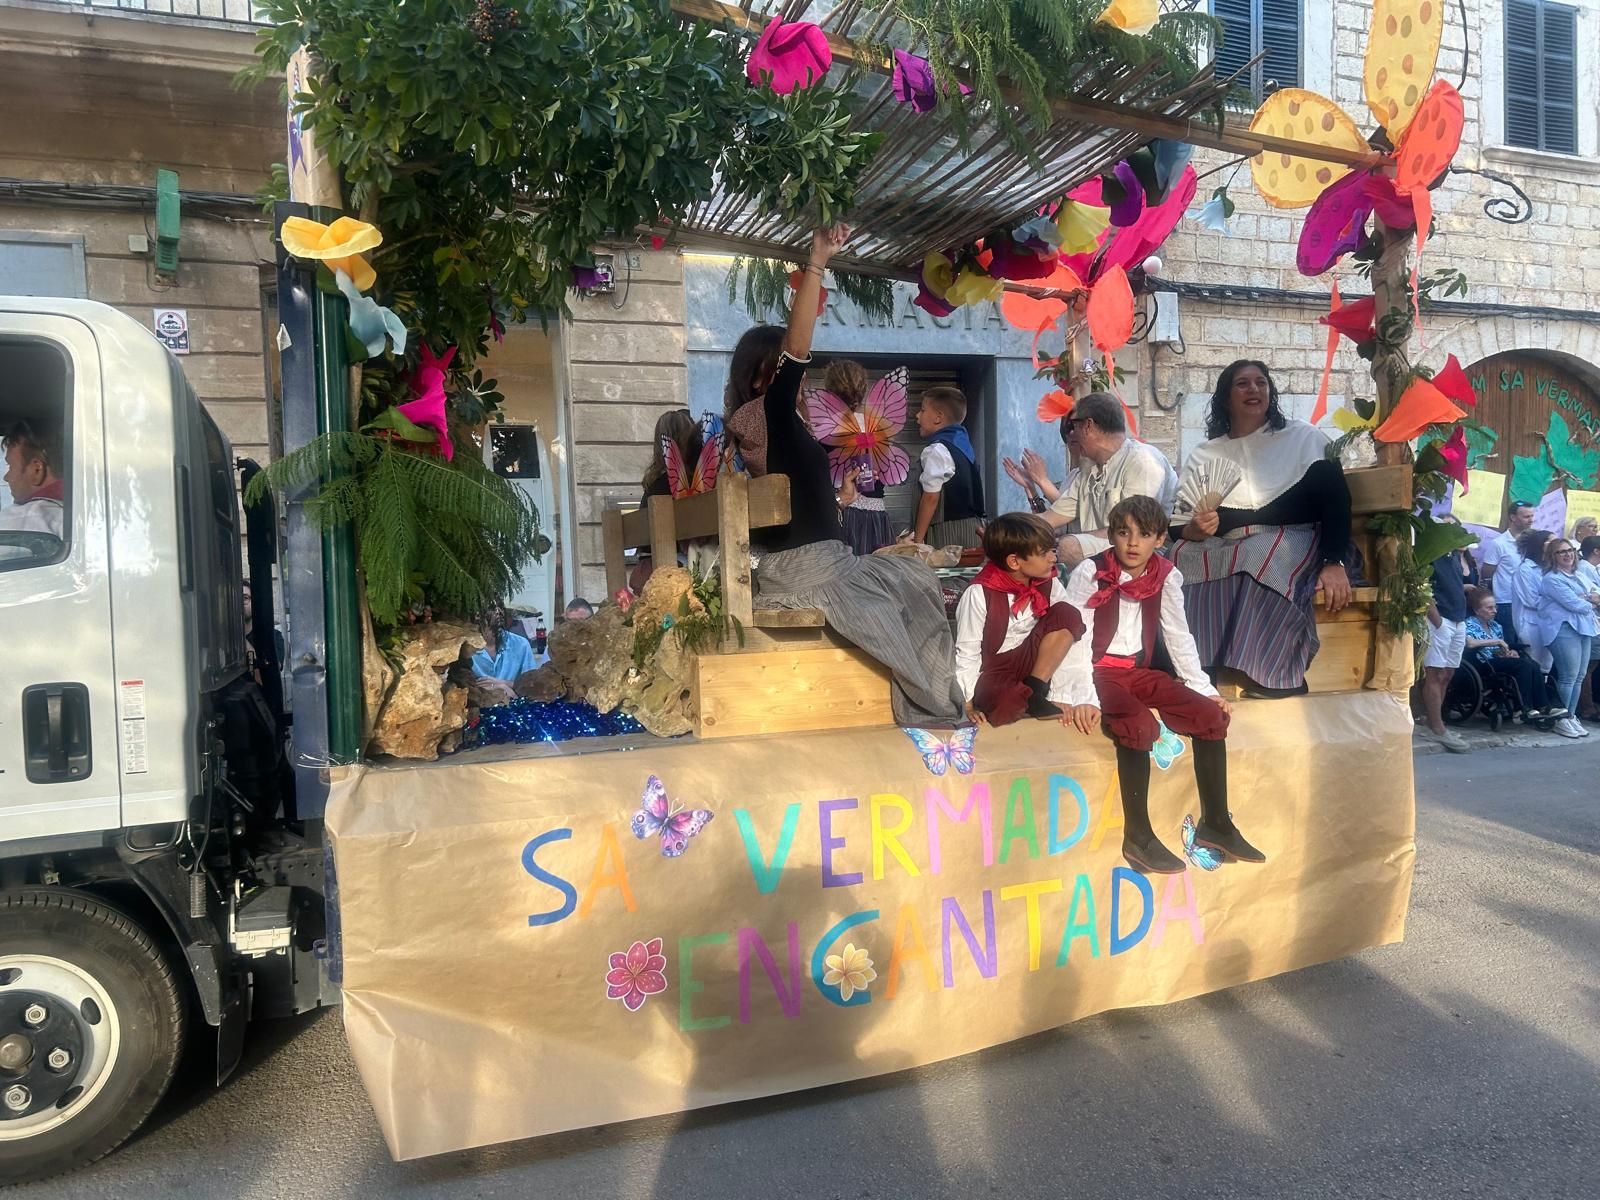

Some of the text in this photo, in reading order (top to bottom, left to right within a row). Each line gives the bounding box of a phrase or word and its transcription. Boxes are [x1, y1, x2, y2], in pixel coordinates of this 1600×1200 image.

[1500, 369, 1525, 392] SA
[521, 823, 637, 927] SA
[678, 866, 1206, 1032] ENCANTADA
